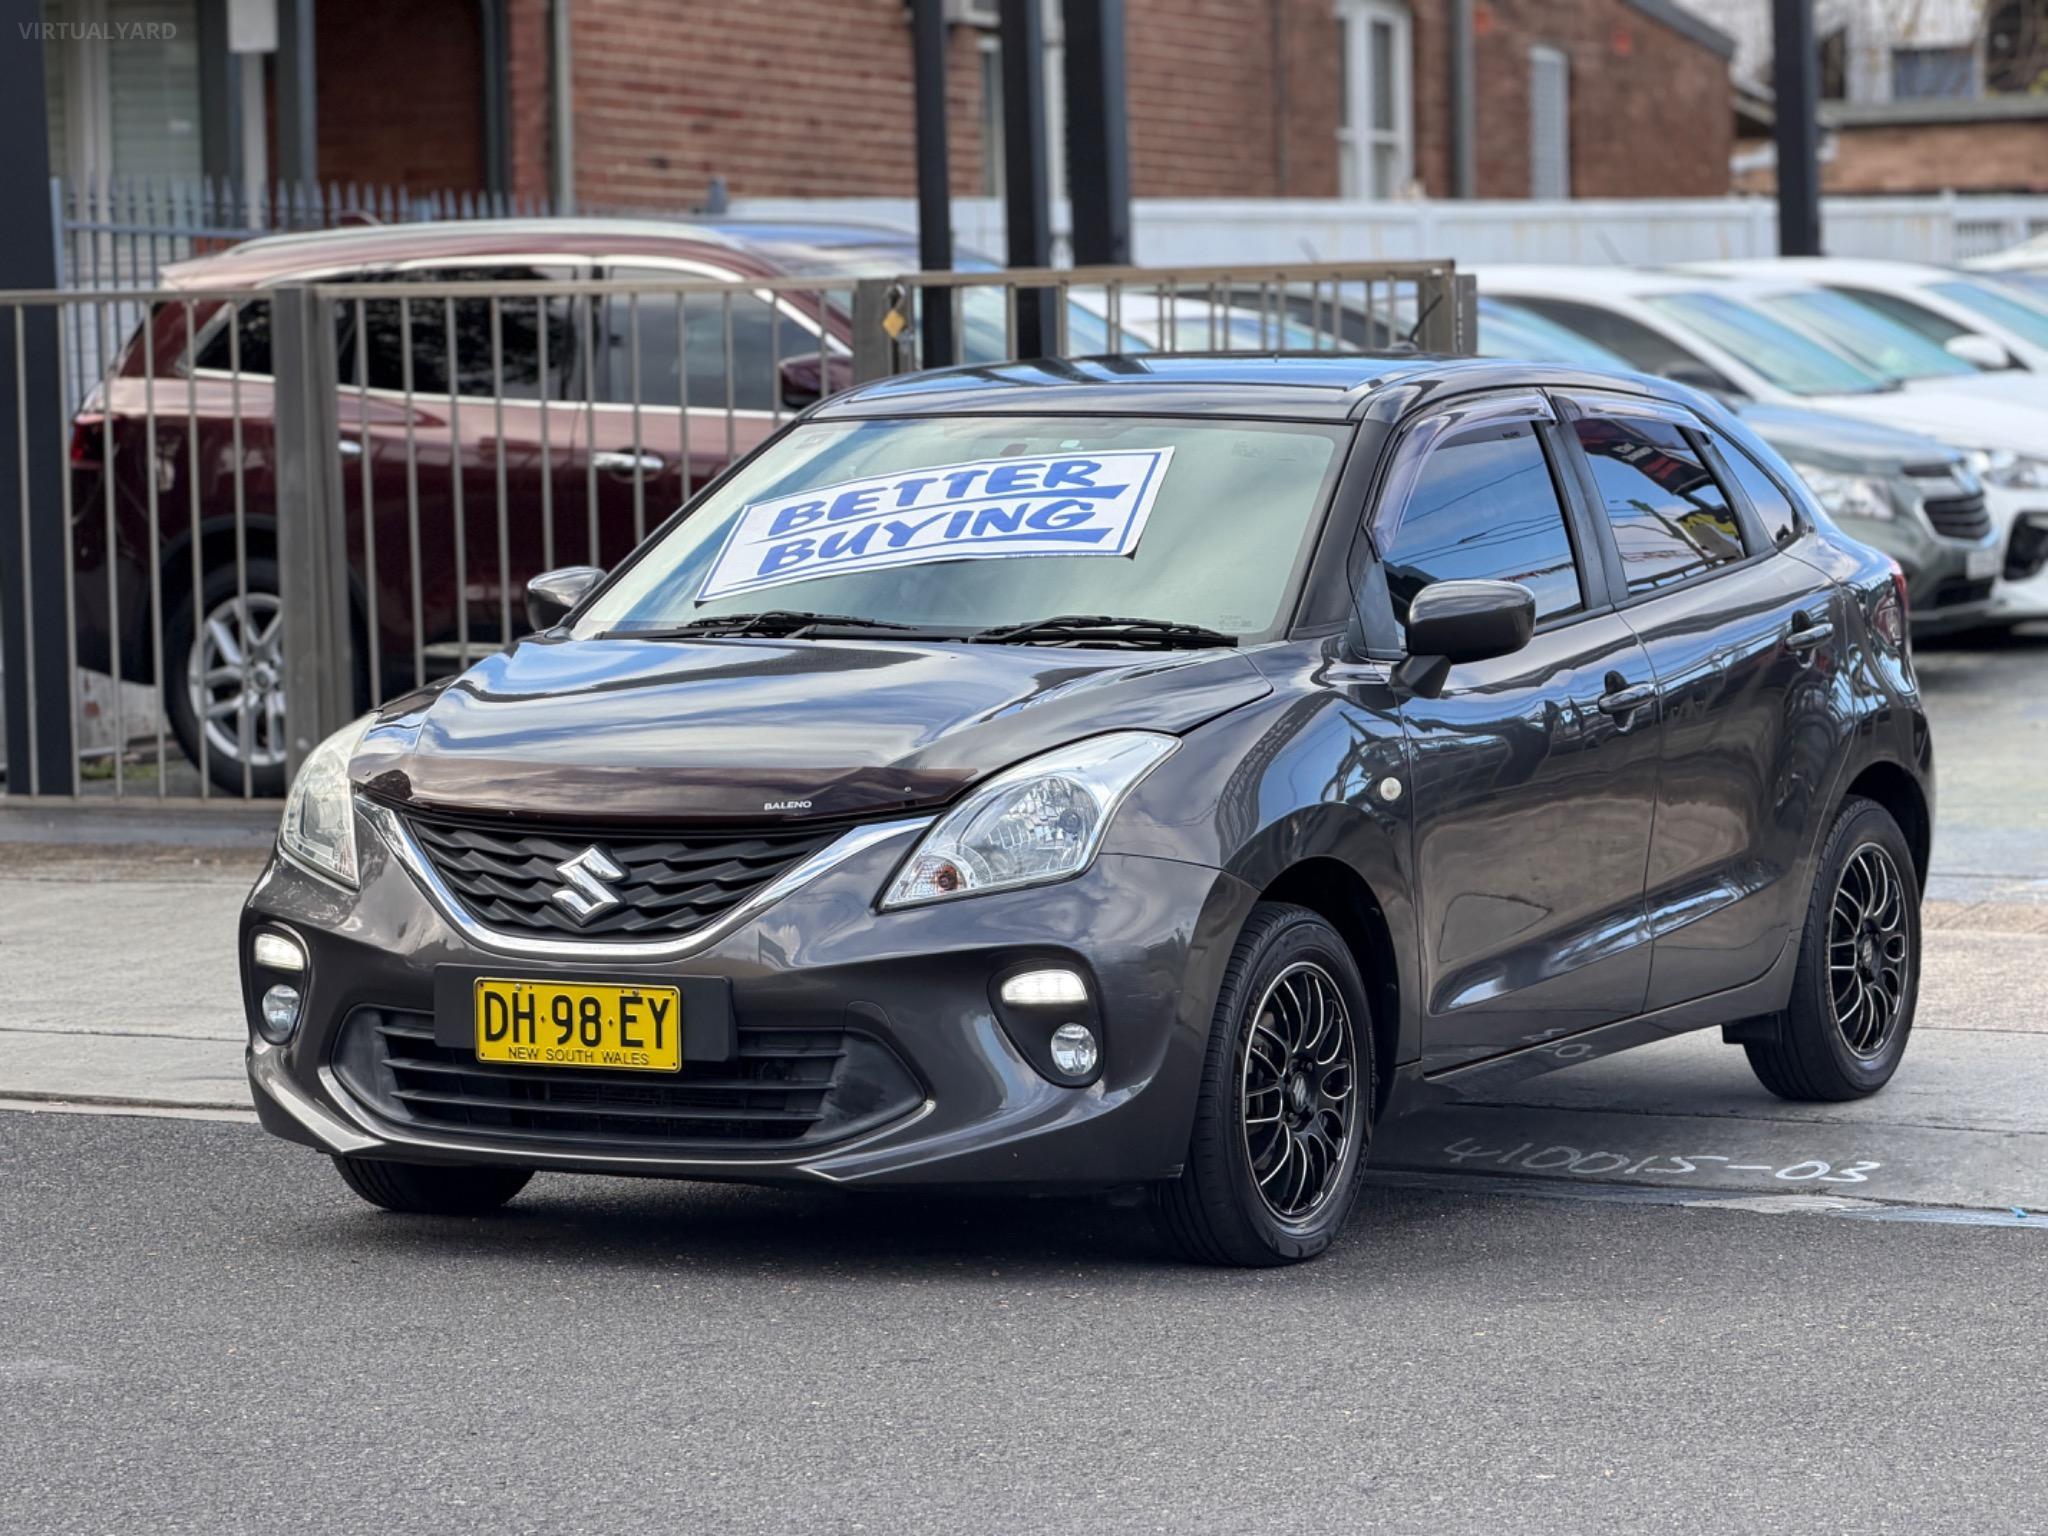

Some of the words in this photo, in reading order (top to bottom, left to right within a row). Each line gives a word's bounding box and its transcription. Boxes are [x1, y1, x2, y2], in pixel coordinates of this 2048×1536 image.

[768, 459, 1104, 537] BETTER
[756, 499, 1097, 576] BUYING
[764, 800, 812, 811] BALENO
[508, 1046, 538, 1060] NEW
[546, 1047, 594, 1063] SOUTH
[602, 1050, 649, 1066] WALES
